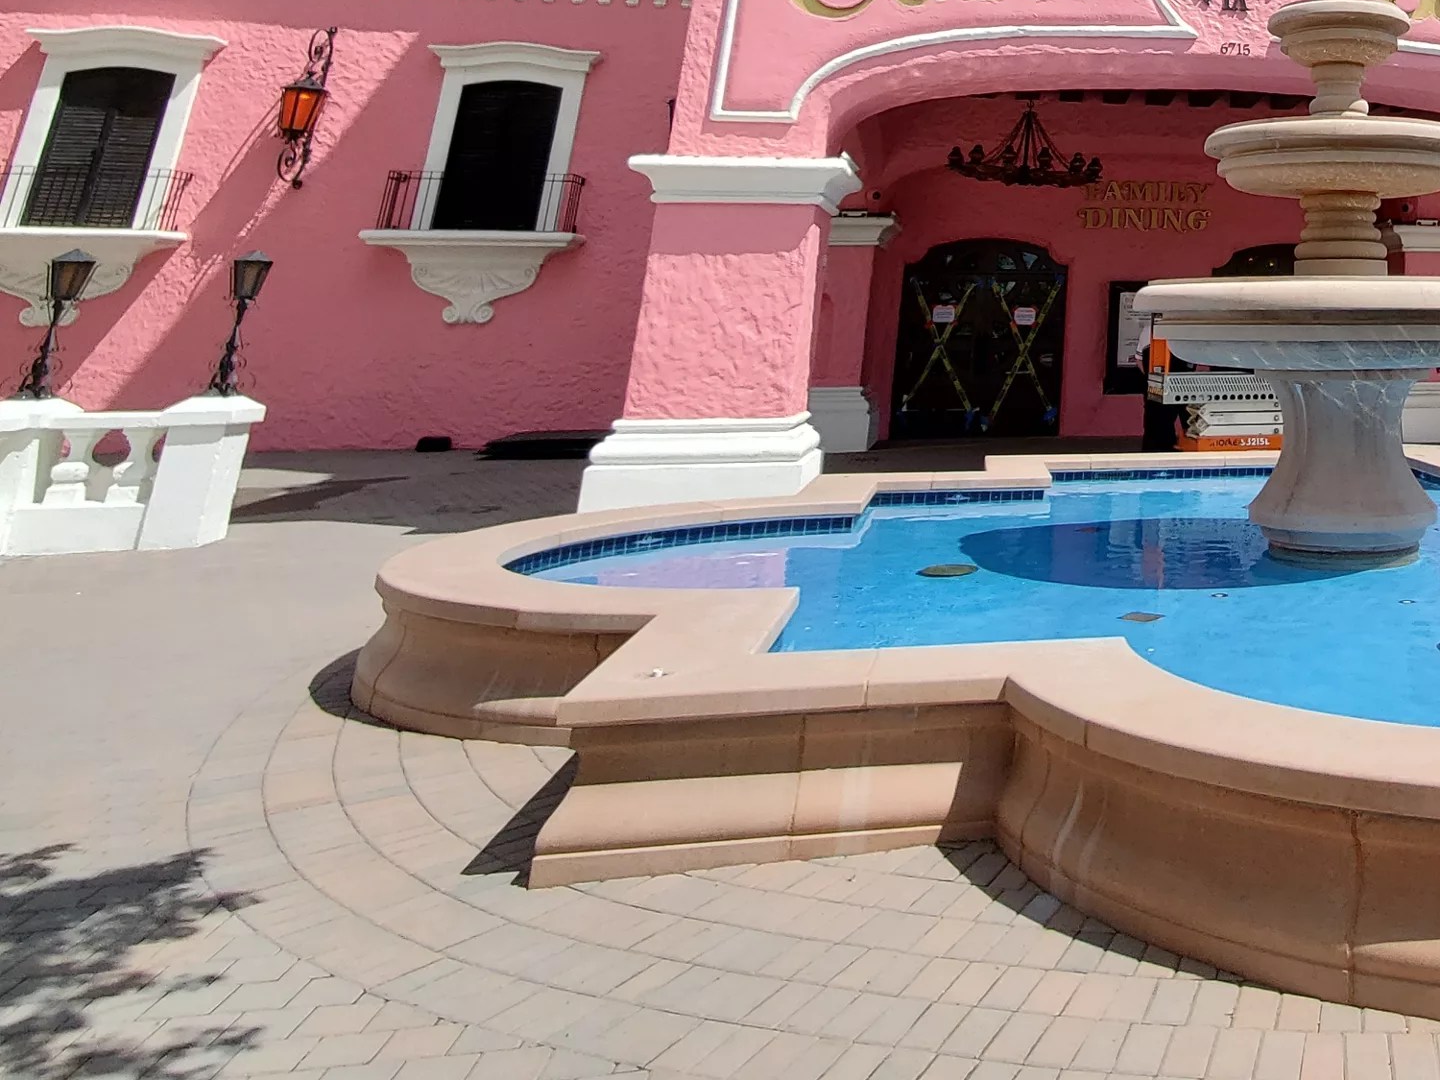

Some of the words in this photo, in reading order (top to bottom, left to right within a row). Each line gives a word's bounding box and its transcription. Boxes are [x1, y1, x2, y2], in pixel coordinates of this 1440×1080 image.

[1220, 42, 1251, 56] 6715
[1083, 180, 1212, 203] FAMILY
[1078, 207, 1212, 233] DINING
